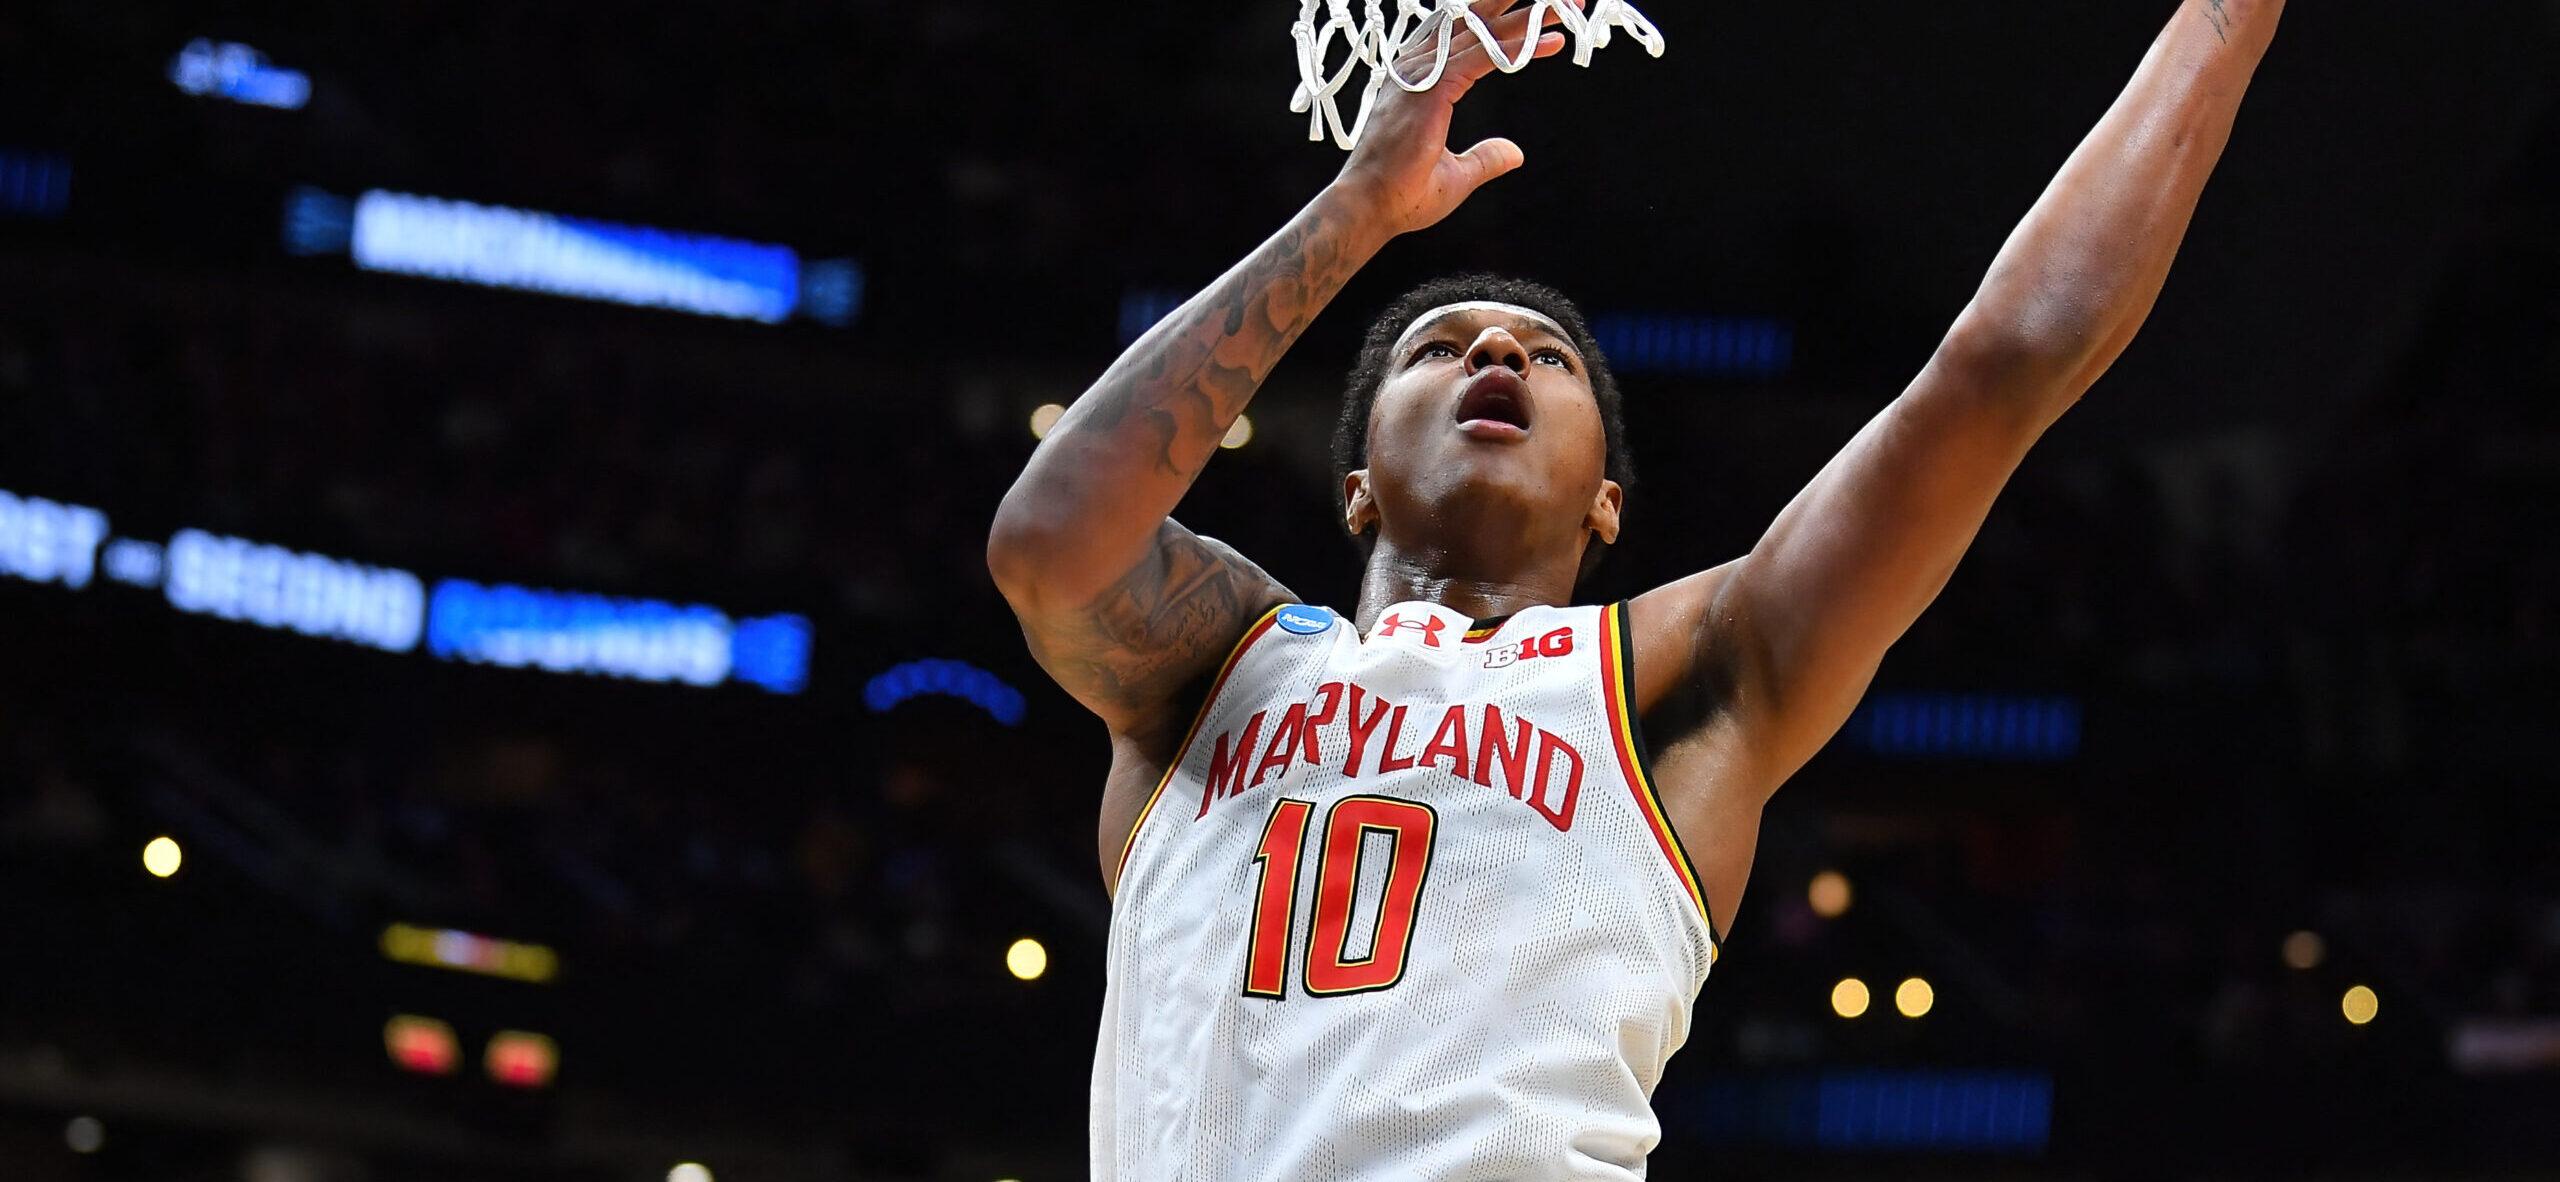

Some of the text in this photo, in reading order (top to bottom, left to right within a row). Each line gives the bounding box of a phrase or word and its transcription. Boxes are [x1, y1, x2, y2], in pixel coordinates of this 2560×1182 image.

[166, 529, 424, 652] SECOND
[1281, 613, 1327, 629] NCAA
[1194, 682, 1584, 832] MARYLAND
[1242, 794, 1438, 1000] 10
